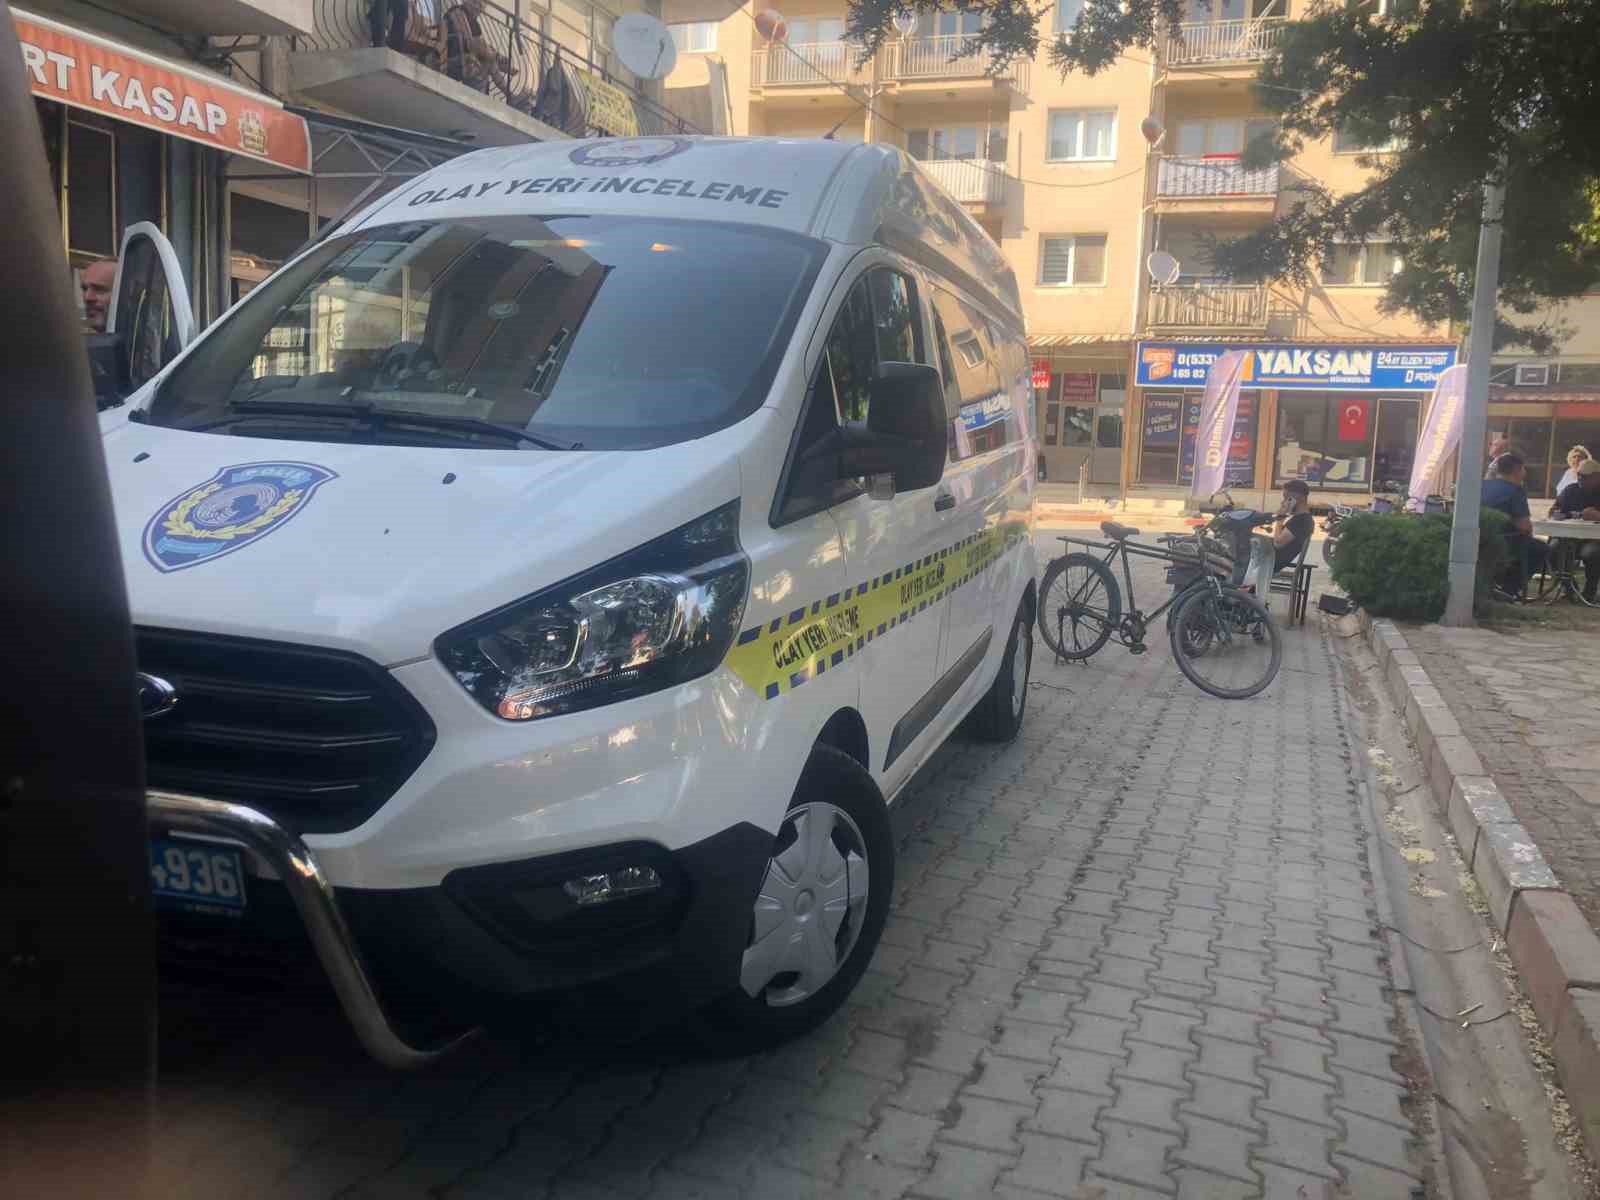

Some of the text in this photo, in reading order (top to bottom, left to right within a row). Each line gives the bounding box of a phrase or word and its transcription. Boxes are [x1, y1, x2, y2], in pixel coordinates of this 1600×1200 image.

[91, 64, 228, 135] KASAP
[408, 181, 503, 208] OLAY
[1257, 349, 1372, 375] YAKSAN
